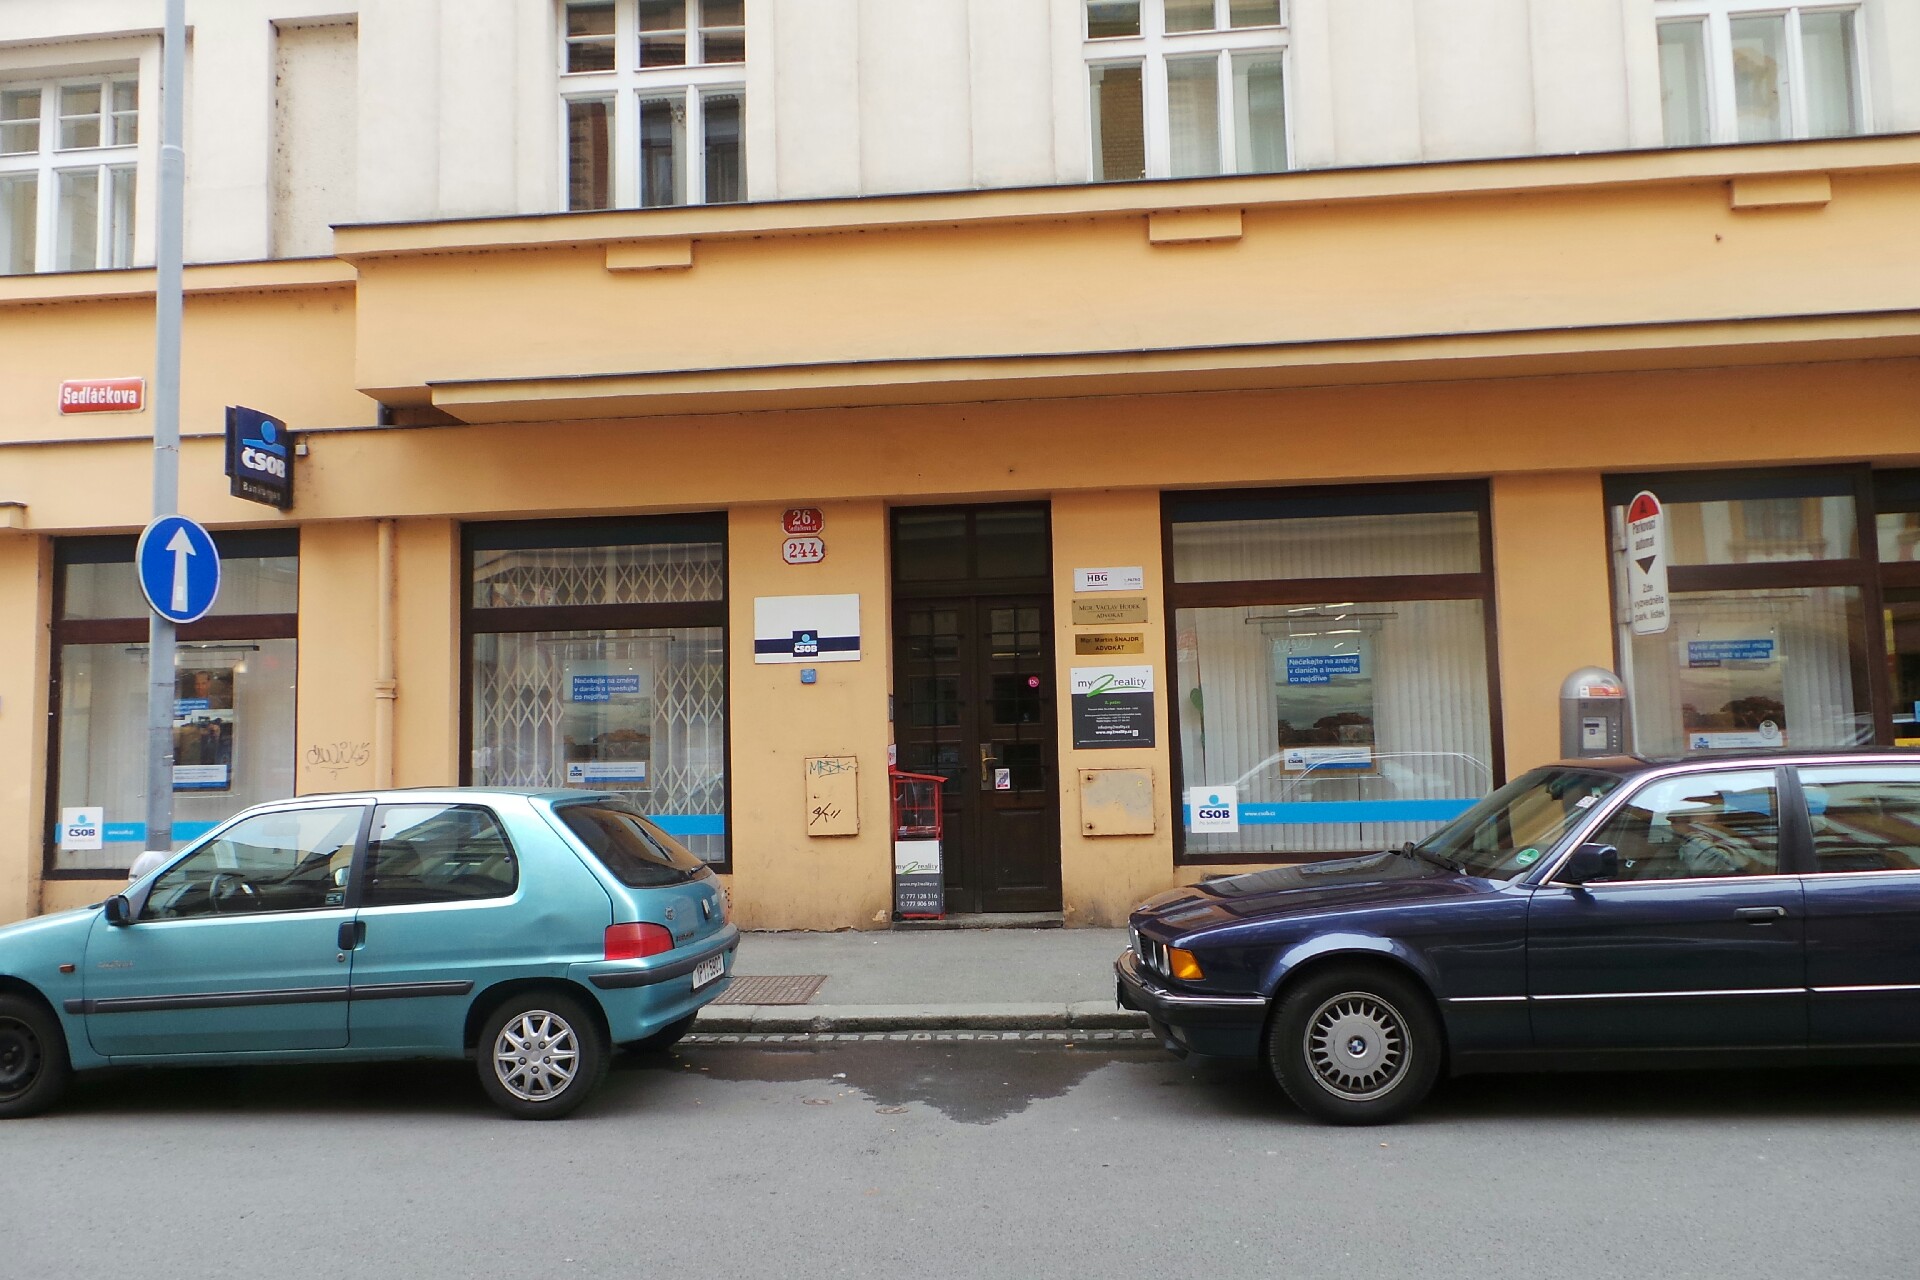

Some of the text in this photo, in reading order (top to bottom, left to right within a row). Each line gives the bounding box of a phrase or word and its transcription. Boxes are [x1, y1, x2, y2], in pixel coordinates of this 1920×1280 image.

[63, 385, 137, 404] Sedláčkova
[241, 446, 286, 478] ČSOB
[788, 542, 818, 558] 244
[1087, 574, 1108, 582] HBG
[1335, 657, 1358, 665] změny
[1325, 665, 1359, 673] investujte
[1198, 809, 1230, 819] ČSOB
[68, 829, 96, 837] ČSOB
